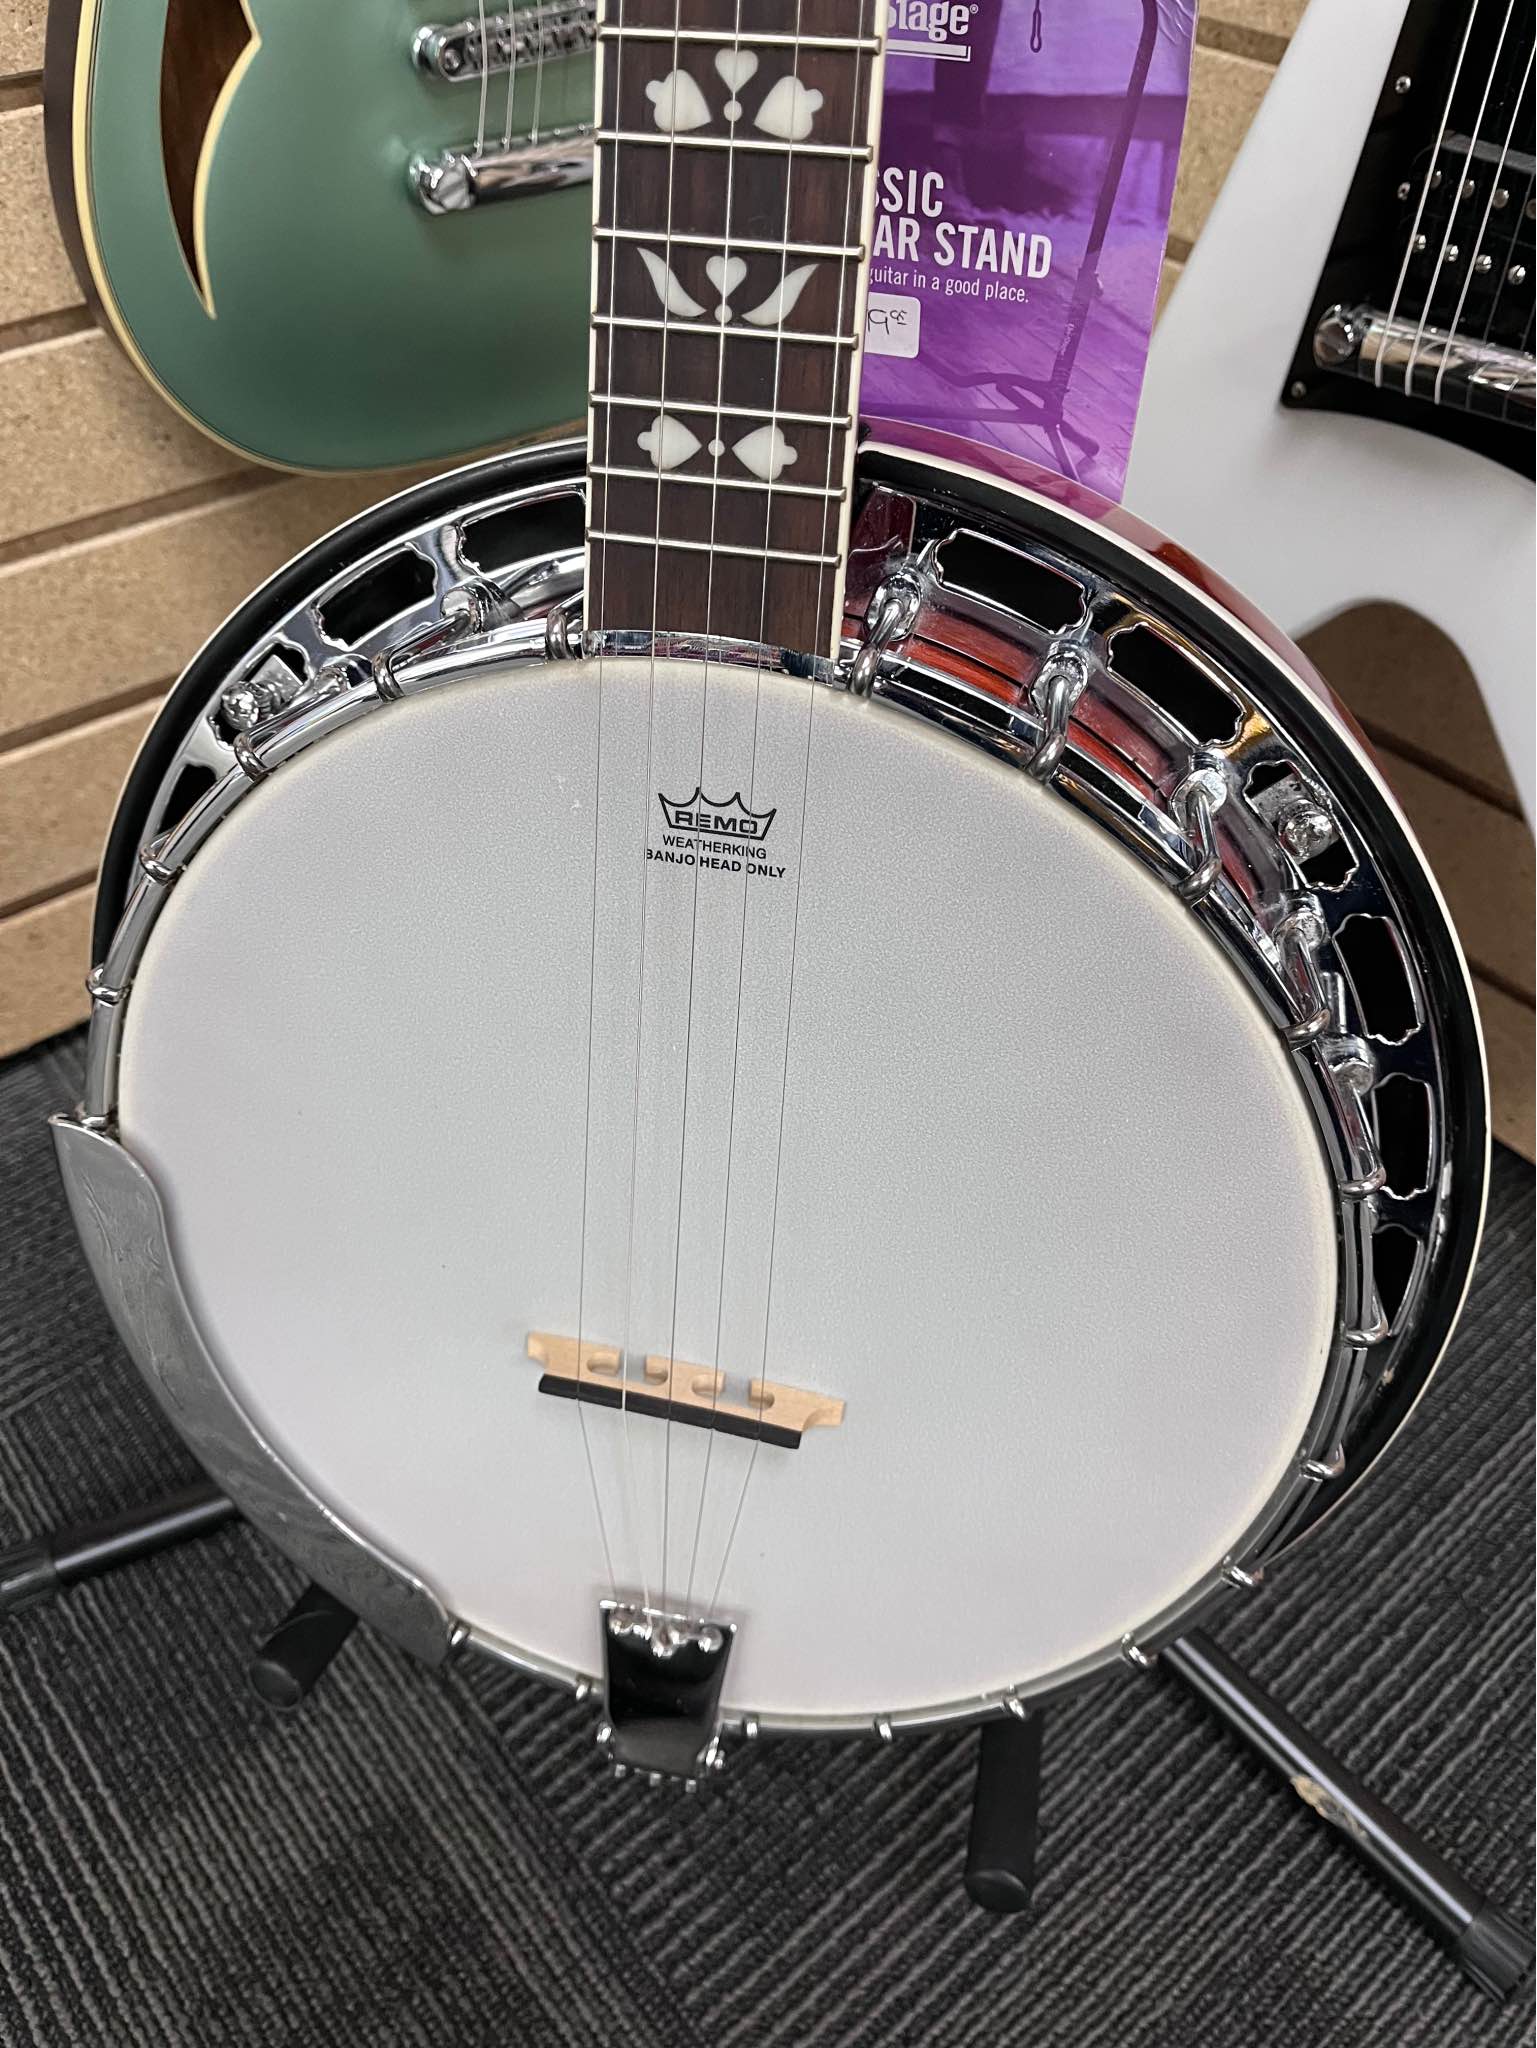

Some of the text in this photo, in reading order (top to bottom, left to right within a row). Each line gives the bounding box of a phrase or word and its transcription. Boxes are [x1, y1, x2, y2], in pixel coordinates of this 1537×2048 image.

[933, 221, 1053, 279] STAND
[913, 269, 926, 288] in
[931, 277, 941, 290] a
[945, 278, 980, 296] good
[985, 281, 1029, 303] place.
[675, 810, 758, 834] REMO
[662, 834, 767, 860] WEATHERKING
[646, 848, 786, 878] BANJO HEAD ONLY
